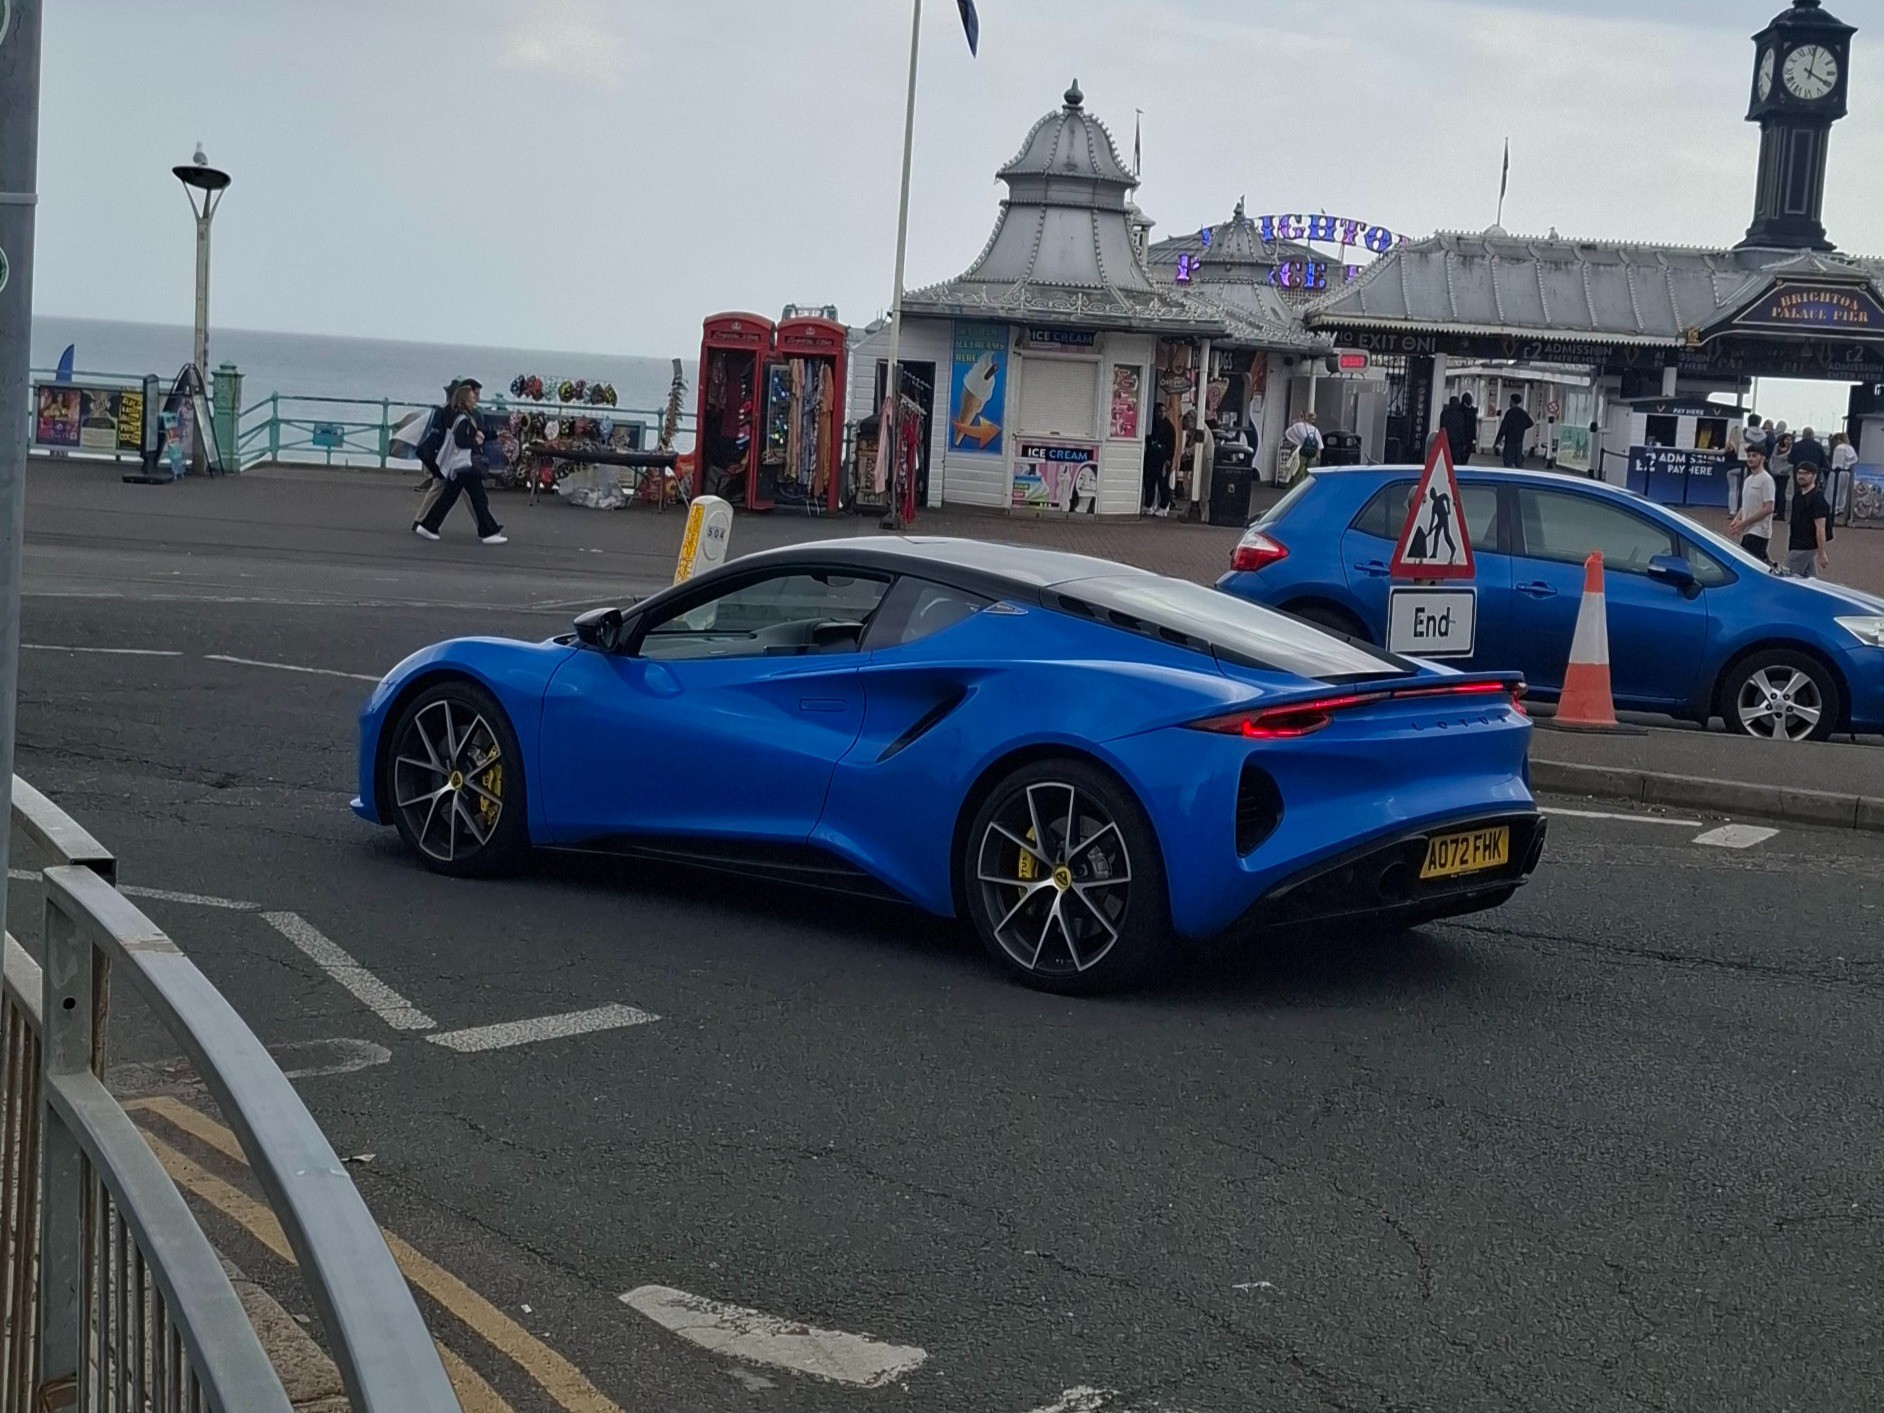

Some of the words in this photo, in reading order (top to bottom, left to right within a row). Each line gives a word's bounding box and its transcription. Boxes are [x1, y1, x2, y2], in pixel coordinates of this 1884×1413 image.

[1772, 306, 1827, 320] PALACE
[1833, 310, 1869, 322] PIER
[1032, 331, 1050, 341] ICE
[1054, 333, 1092, 344] CREAM
[1359, 333, 1398, 350] EXIT
[1523, 342, 1542, 360] £2
[1544, 343, 1613, 357] ADMISSION
[1028, 448, 1046, 458] ICE
[1049, 449, 1088, 461] CREAM
[1659, 452, 1726, 465] ADMSSION
[1667, 464, 1686, 474] PAY
[1413, 606, 1451, 637] End
[1411, 714, 1507, 731] LOTUS
[1473, 830, 1503, 863] FHK
